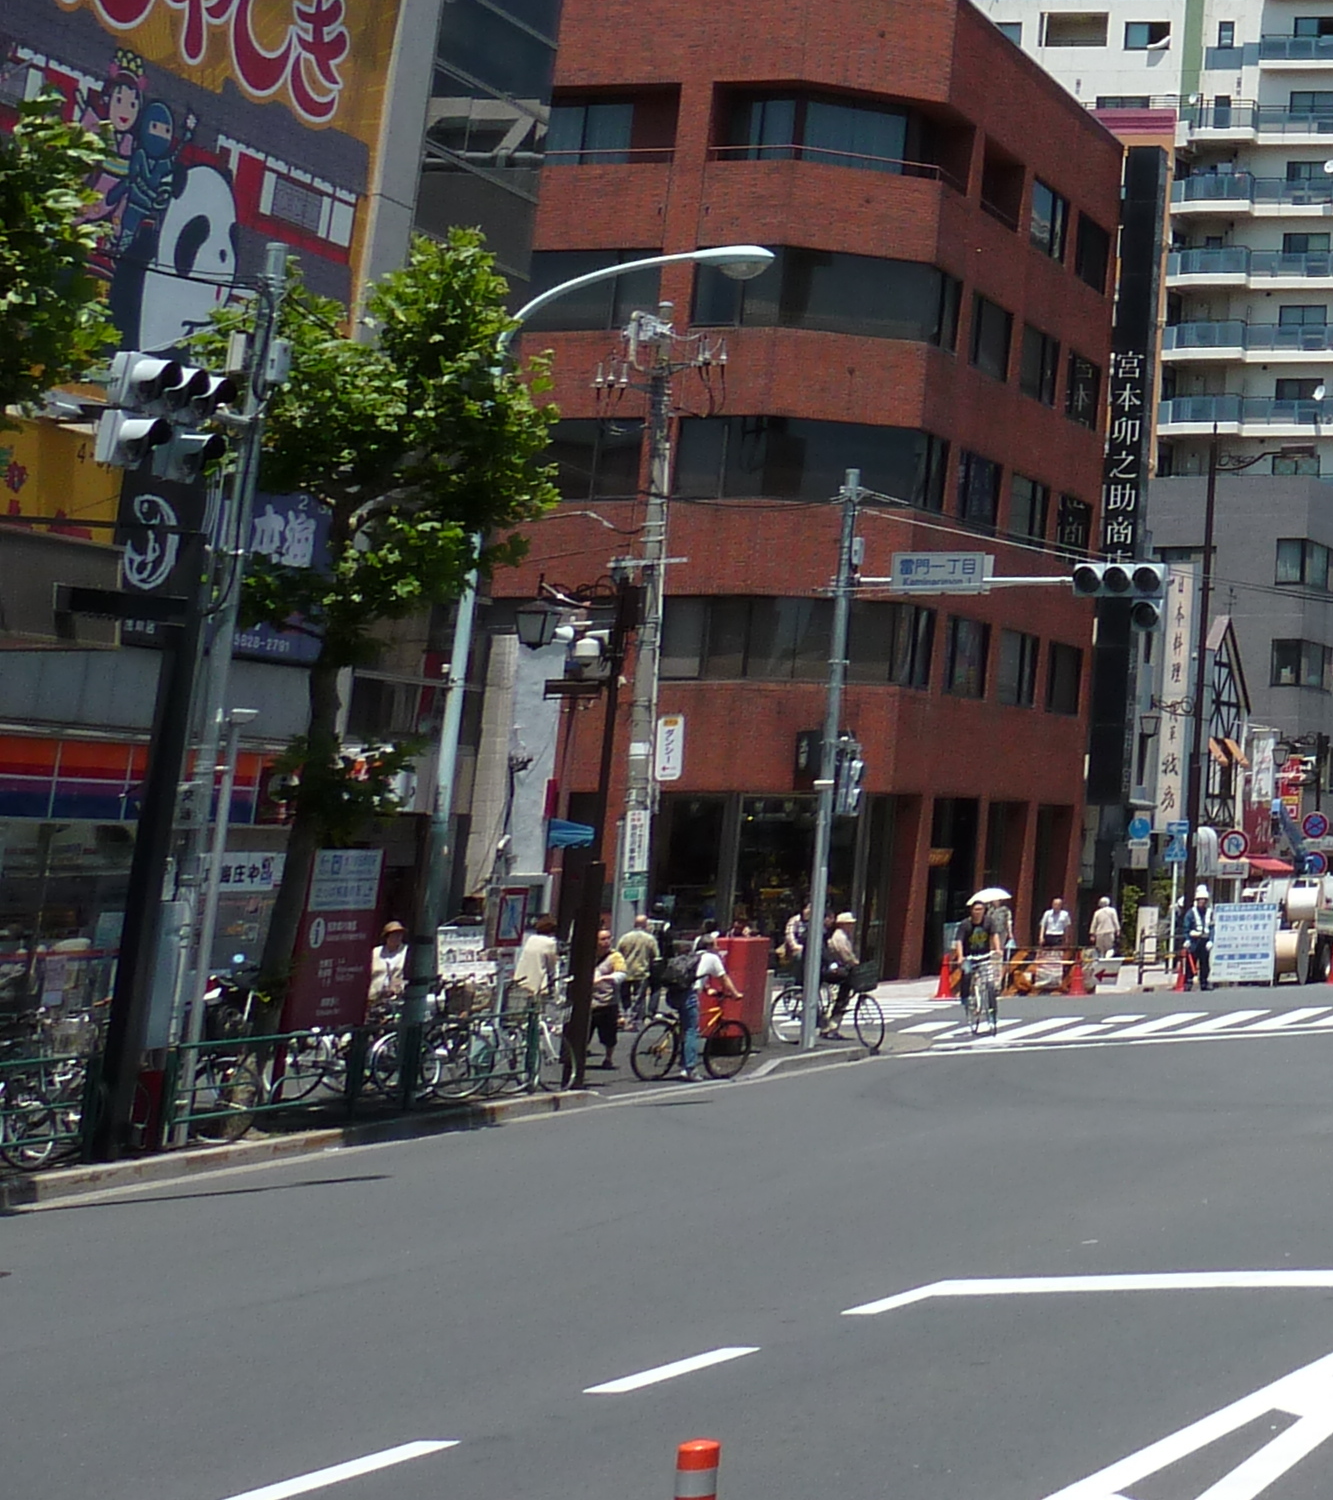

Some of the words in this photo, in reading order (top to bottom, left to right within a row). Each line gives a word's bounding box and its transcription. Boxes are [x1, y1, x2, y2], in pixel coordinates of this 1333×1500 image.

[900, 559, 976, 575] 雷門一丁目
[1170, 577, 1186, 685] 日本料理
